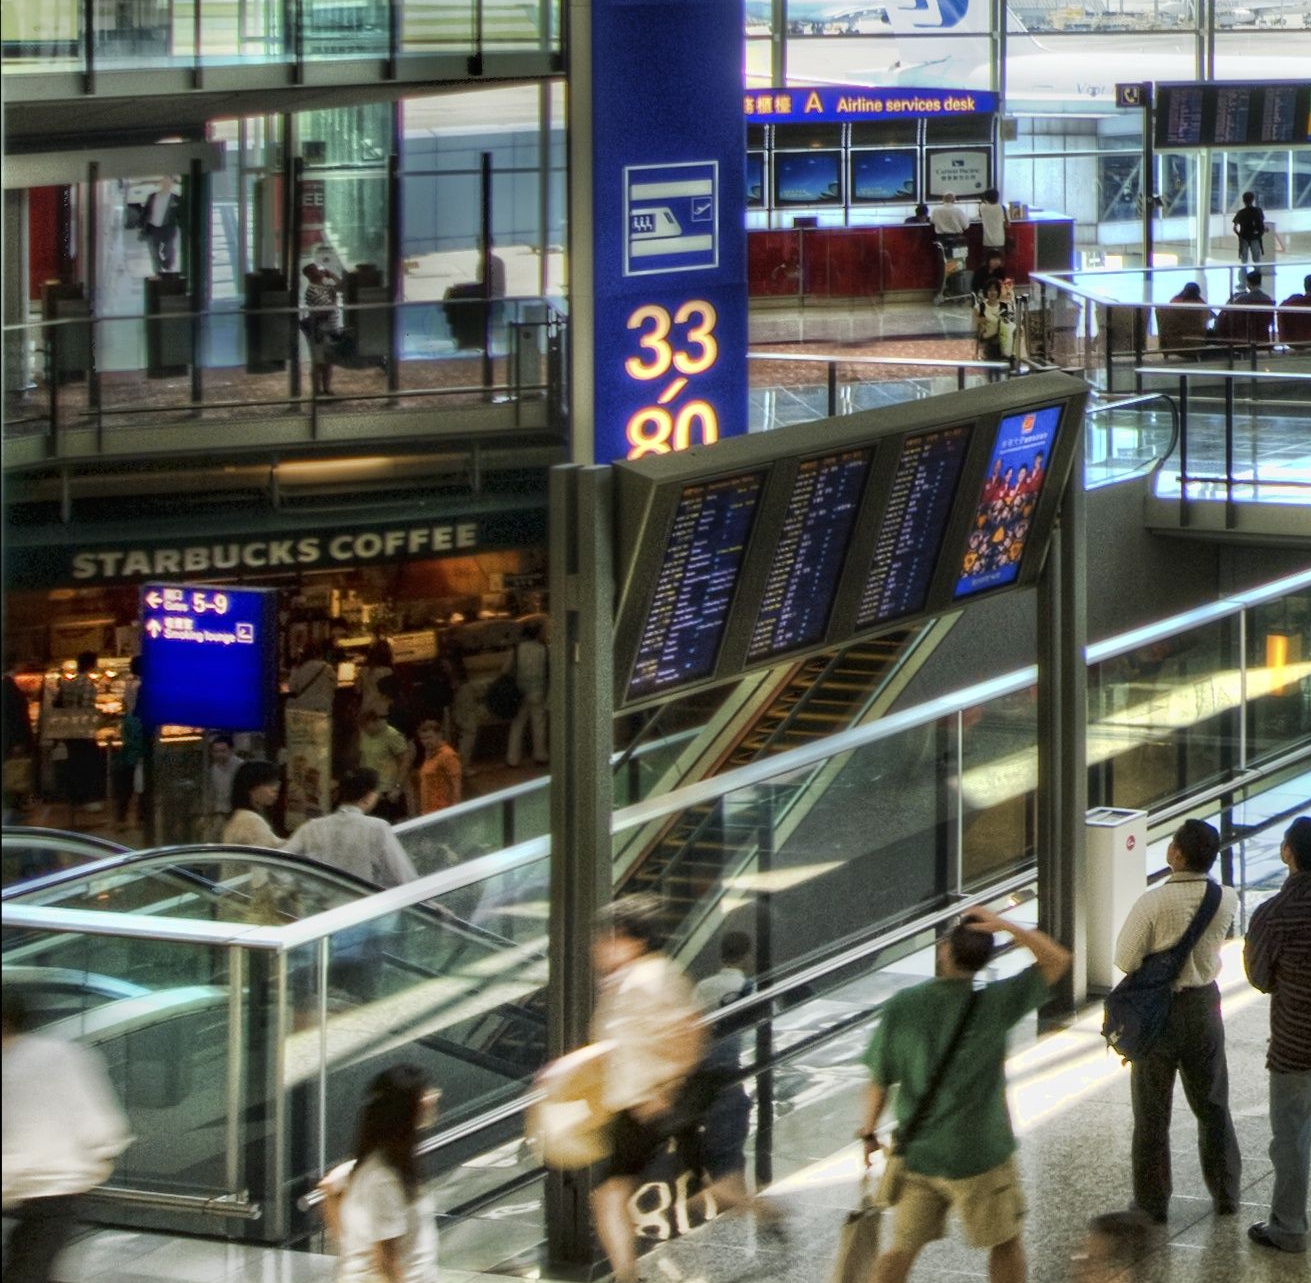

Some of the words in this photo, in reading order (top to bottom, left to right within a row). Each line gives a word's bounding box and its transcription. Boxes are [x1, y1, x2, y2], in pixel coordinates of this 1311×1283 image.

[805, 91, 823, 113] A
[836, 96, 882, 113] Airline
[885, 96, 941, 113] services
[944, 95, 975, 111] desk
[625, 299, 718, 381] 33
[626, 399, 719, 461] 80
[72, 537, 320, 580] STARBUCKS
[329, 523, 478, 562] COFFEE
[192, 592, 228, 615] 5-9
